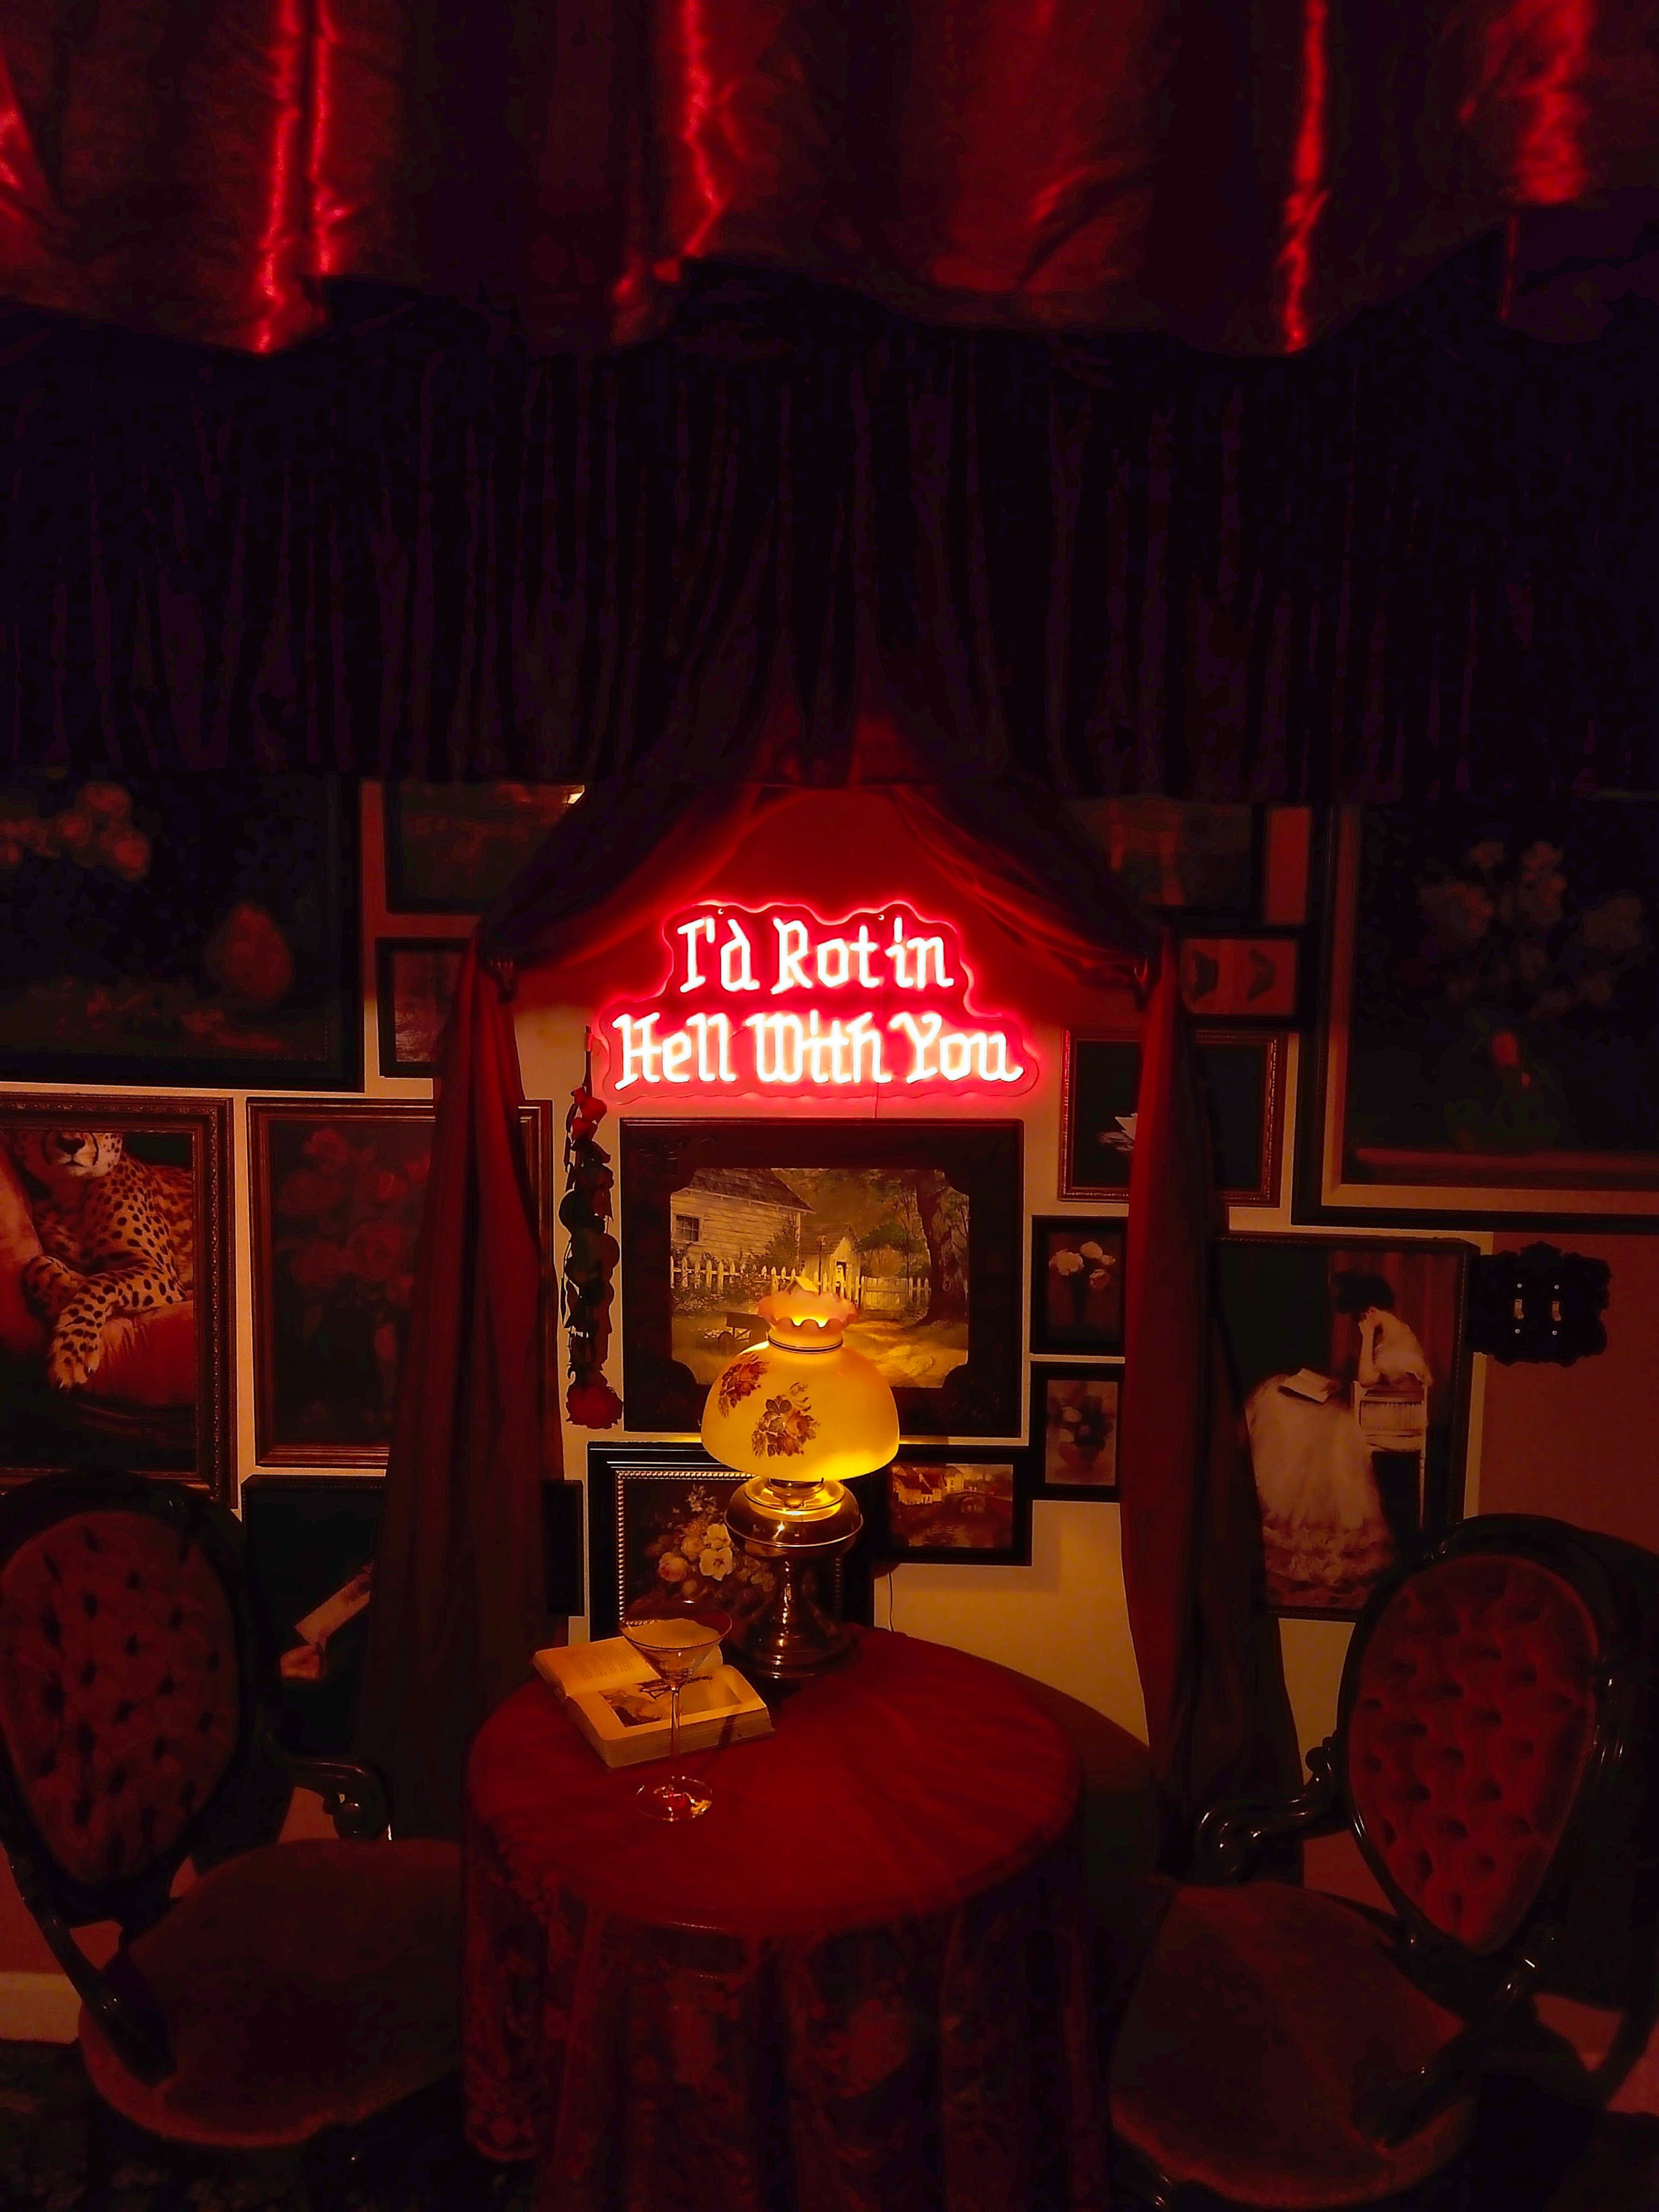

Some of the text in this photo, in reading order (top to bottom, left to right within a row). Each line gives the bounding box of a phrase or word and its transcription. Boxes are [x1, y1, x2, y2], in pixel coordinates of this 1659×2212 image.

[677, 917, 954, 995] I'd Rot in
[611, 1009, 1025, 1090] Hell With You
